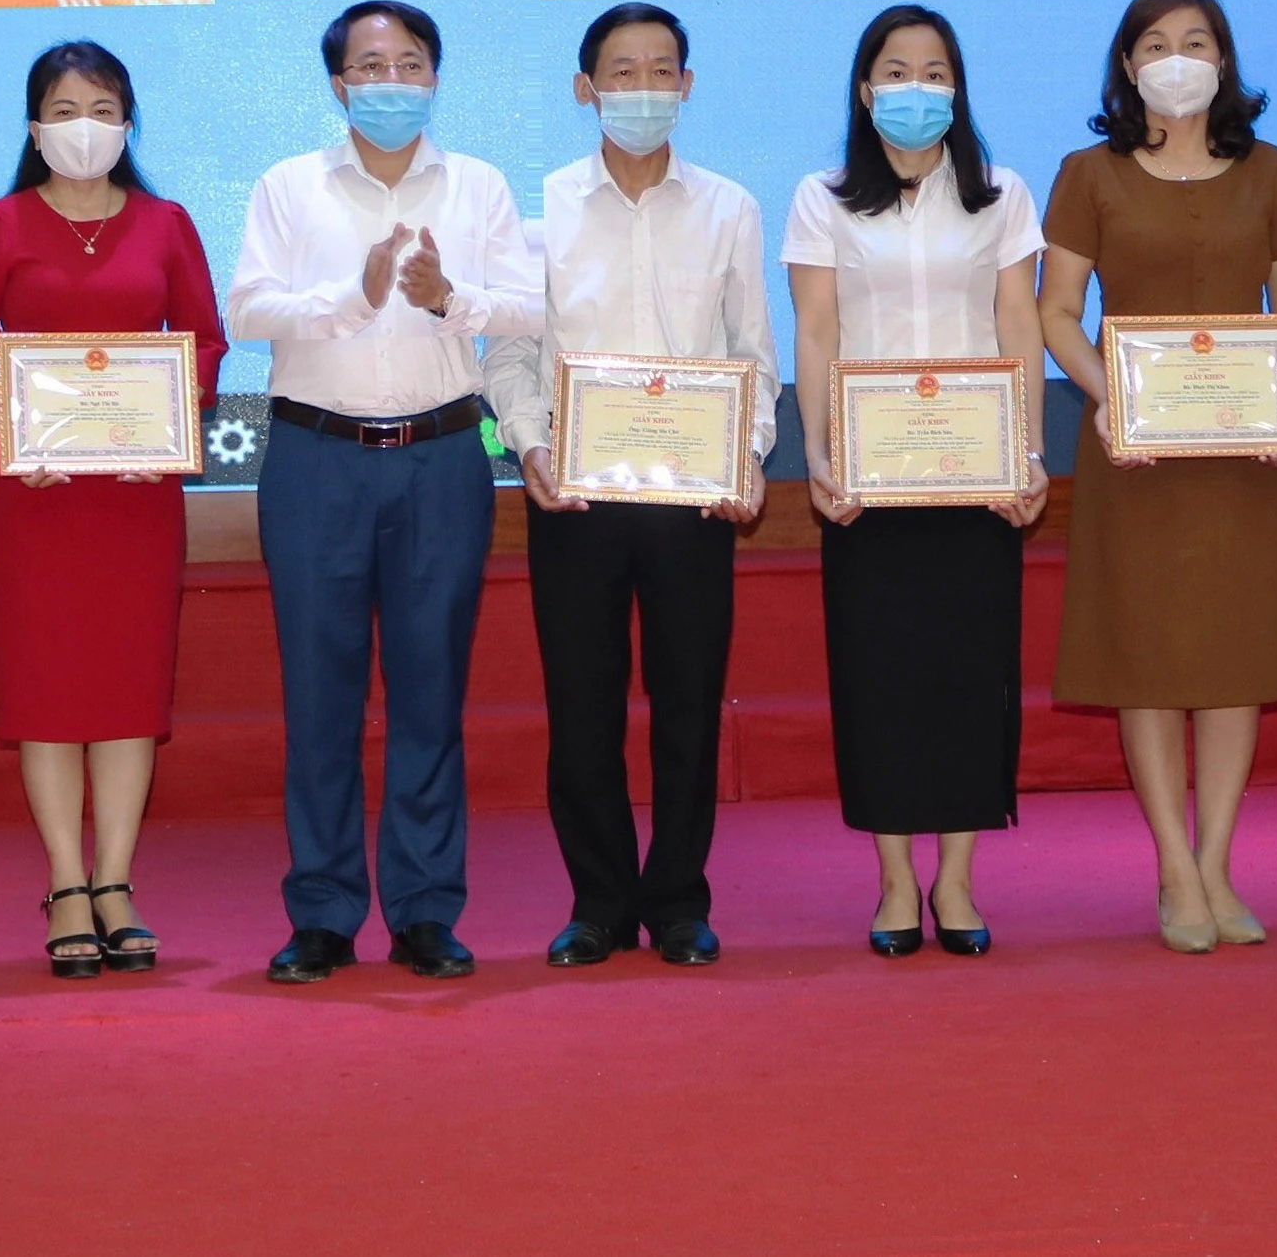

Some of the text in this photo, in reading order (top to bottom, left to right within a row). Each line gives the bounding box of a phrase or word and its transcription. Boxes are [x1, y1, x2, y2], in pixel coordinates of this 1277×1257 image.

[1184, 372, 1203, 380] GIẤY
[80, 388, 96, 397] IẤY
[908, 418, 926, 426] GIẤY
